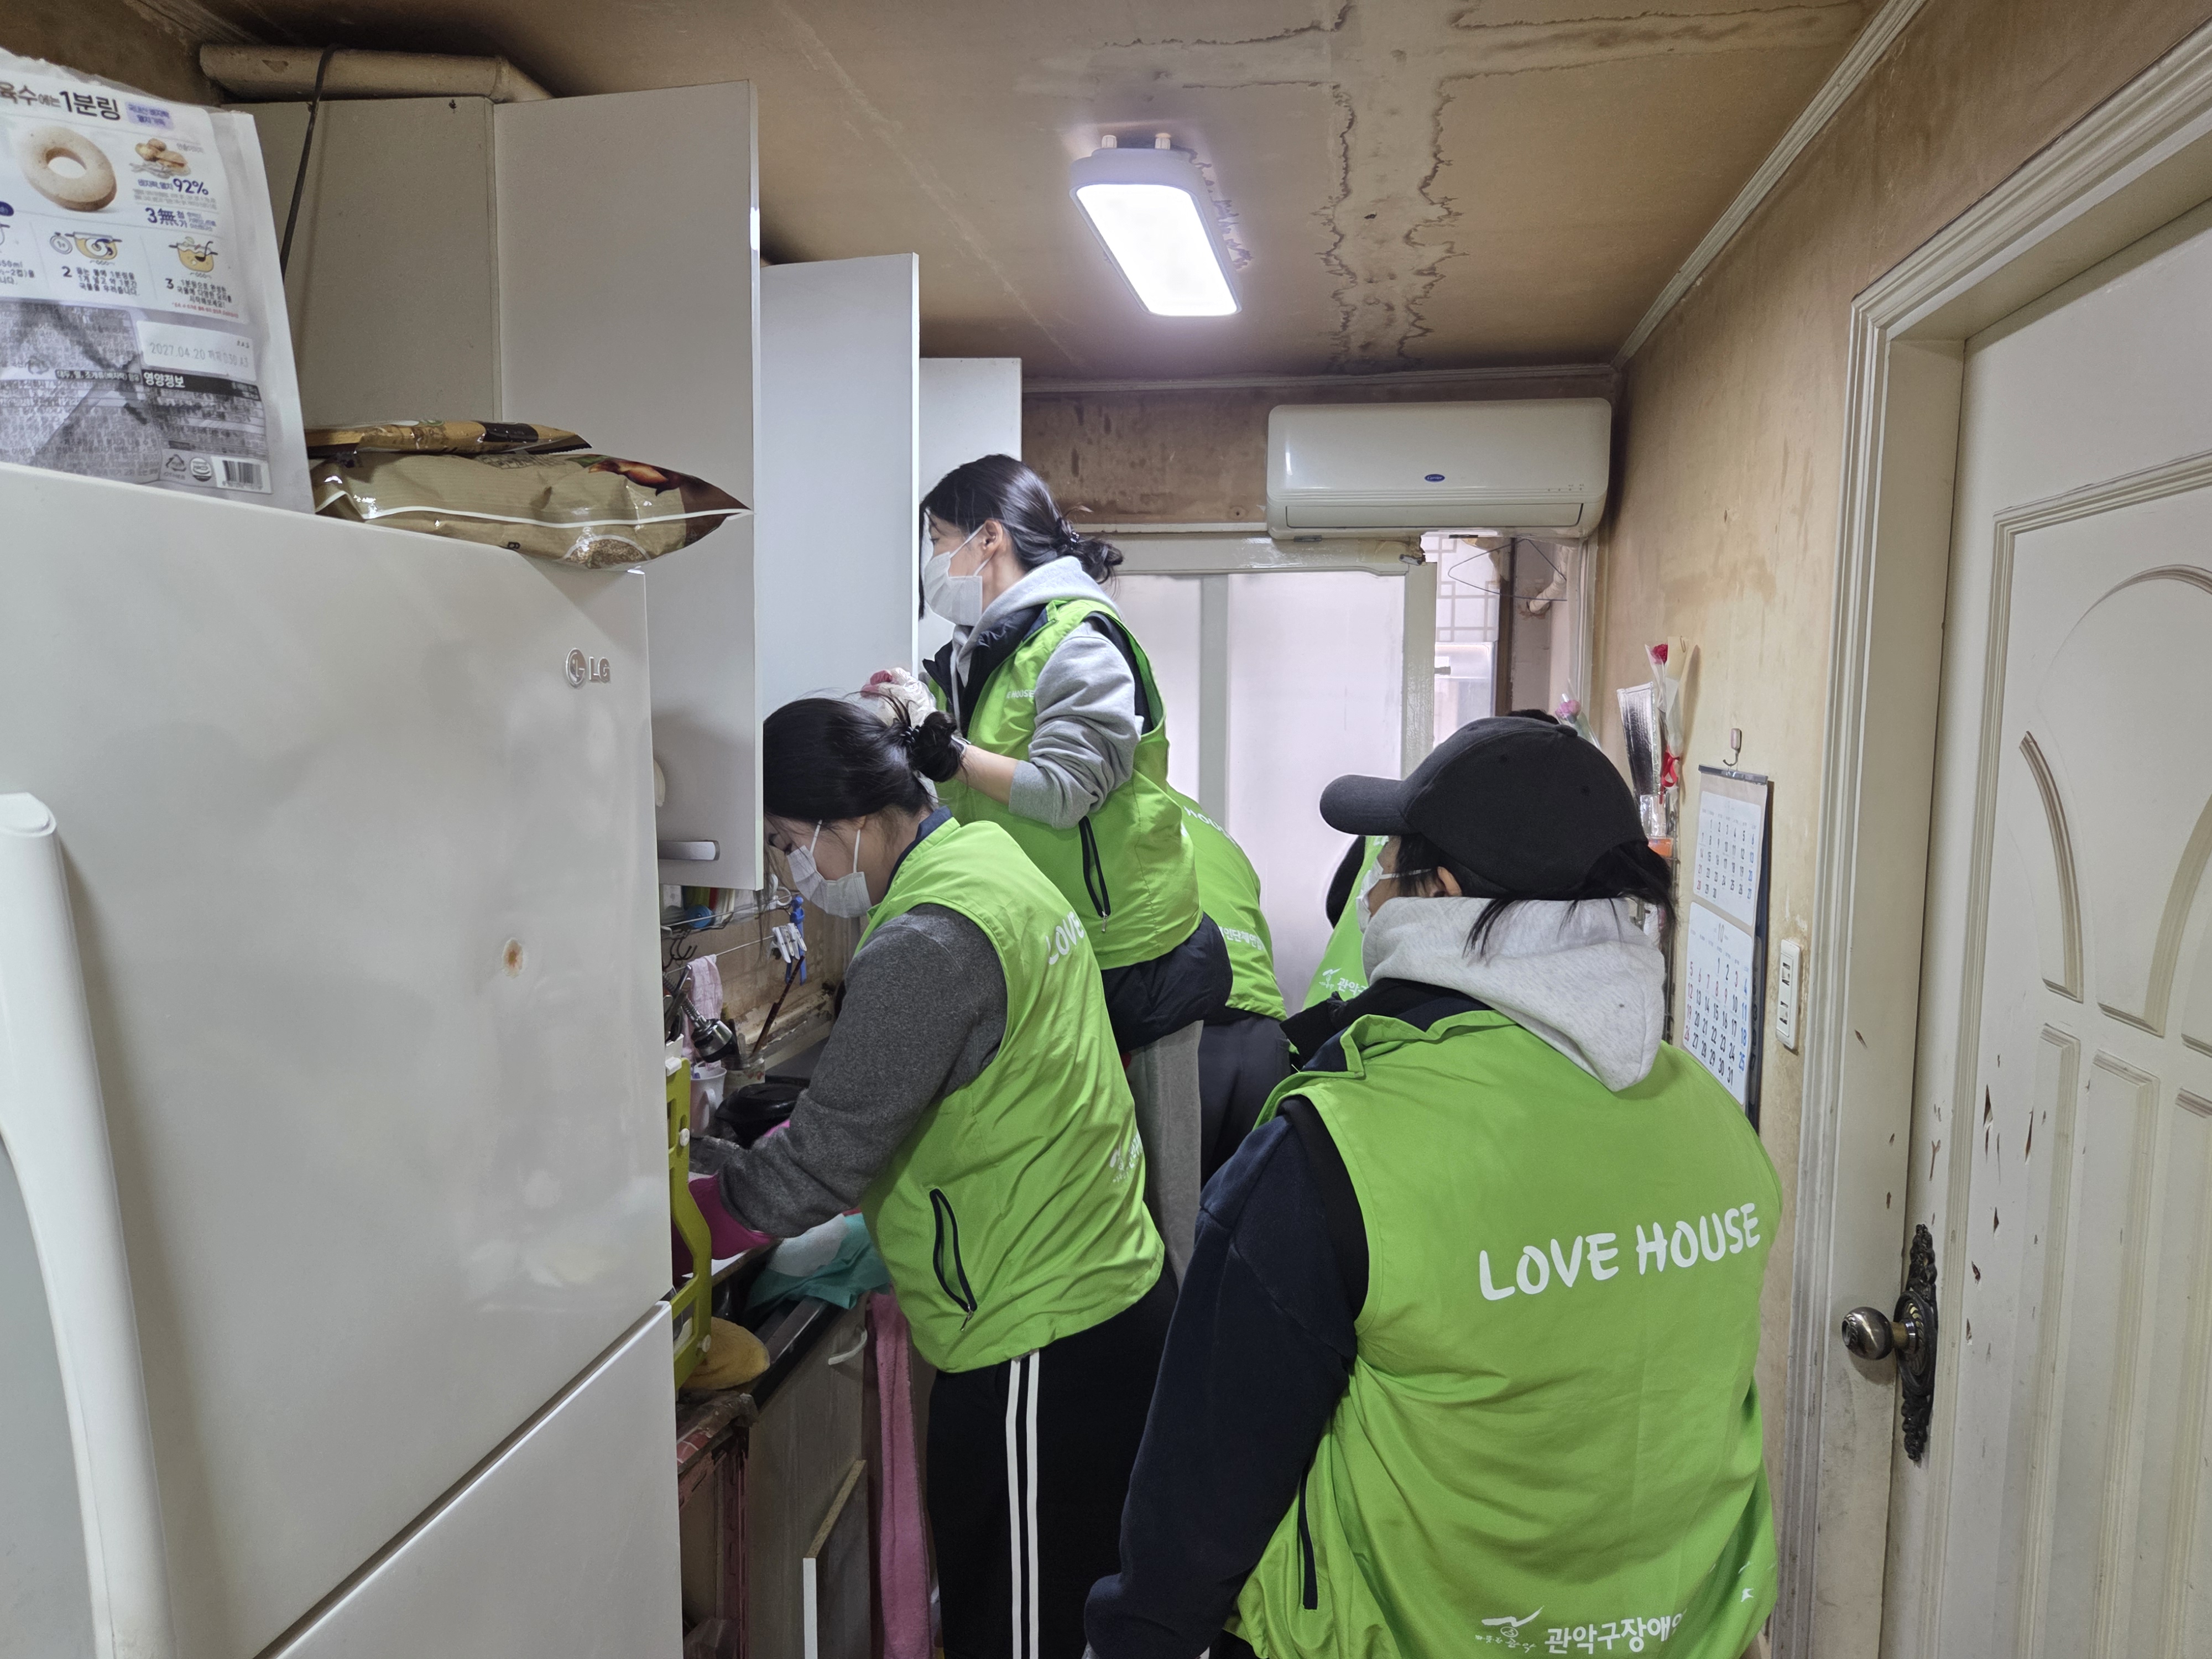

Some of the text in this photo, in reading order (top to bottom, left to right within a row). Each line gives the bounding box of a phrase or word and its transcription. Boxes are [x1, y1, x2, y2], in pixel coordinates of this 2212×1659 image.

[59, 91, 121, 121] 1분링
[173, 178, 208, 195] 92%
[62, 266, 72, 277] 2
[165, 278, 174, 289] 3
[143, 372, 185, 388] 영양정보
[589, 656, 611, 682] LG
[1045, 911, 1084, 965] LOVE
[1718, 923, 1724, 943] 10
[1690, 961, 1747, 1021] 5 6 7 8 9 10 11
[1717, 958, 1747, 995] 1 2 3 4
[1688, 982, 1747, 1046] 12 13 14 15 16 17 18
[1687, 1004, 1692, 1020] 19
[1694, 1010, 1700, 1027] 20
[1702, 1018, 1708, 1035] 21
[1711, 1025, 1717, 1045] 22
[1720, 1034, 1726, 1052] 23
[1729, 1042, 1735, 1062] 24
[1739, 1051, 1745, 1072] 25
[1684, 1025, 1733, 1086] 26 27 28 29 30 31
[1479, 1203, 1760, 1301] LOVE HOUSE
